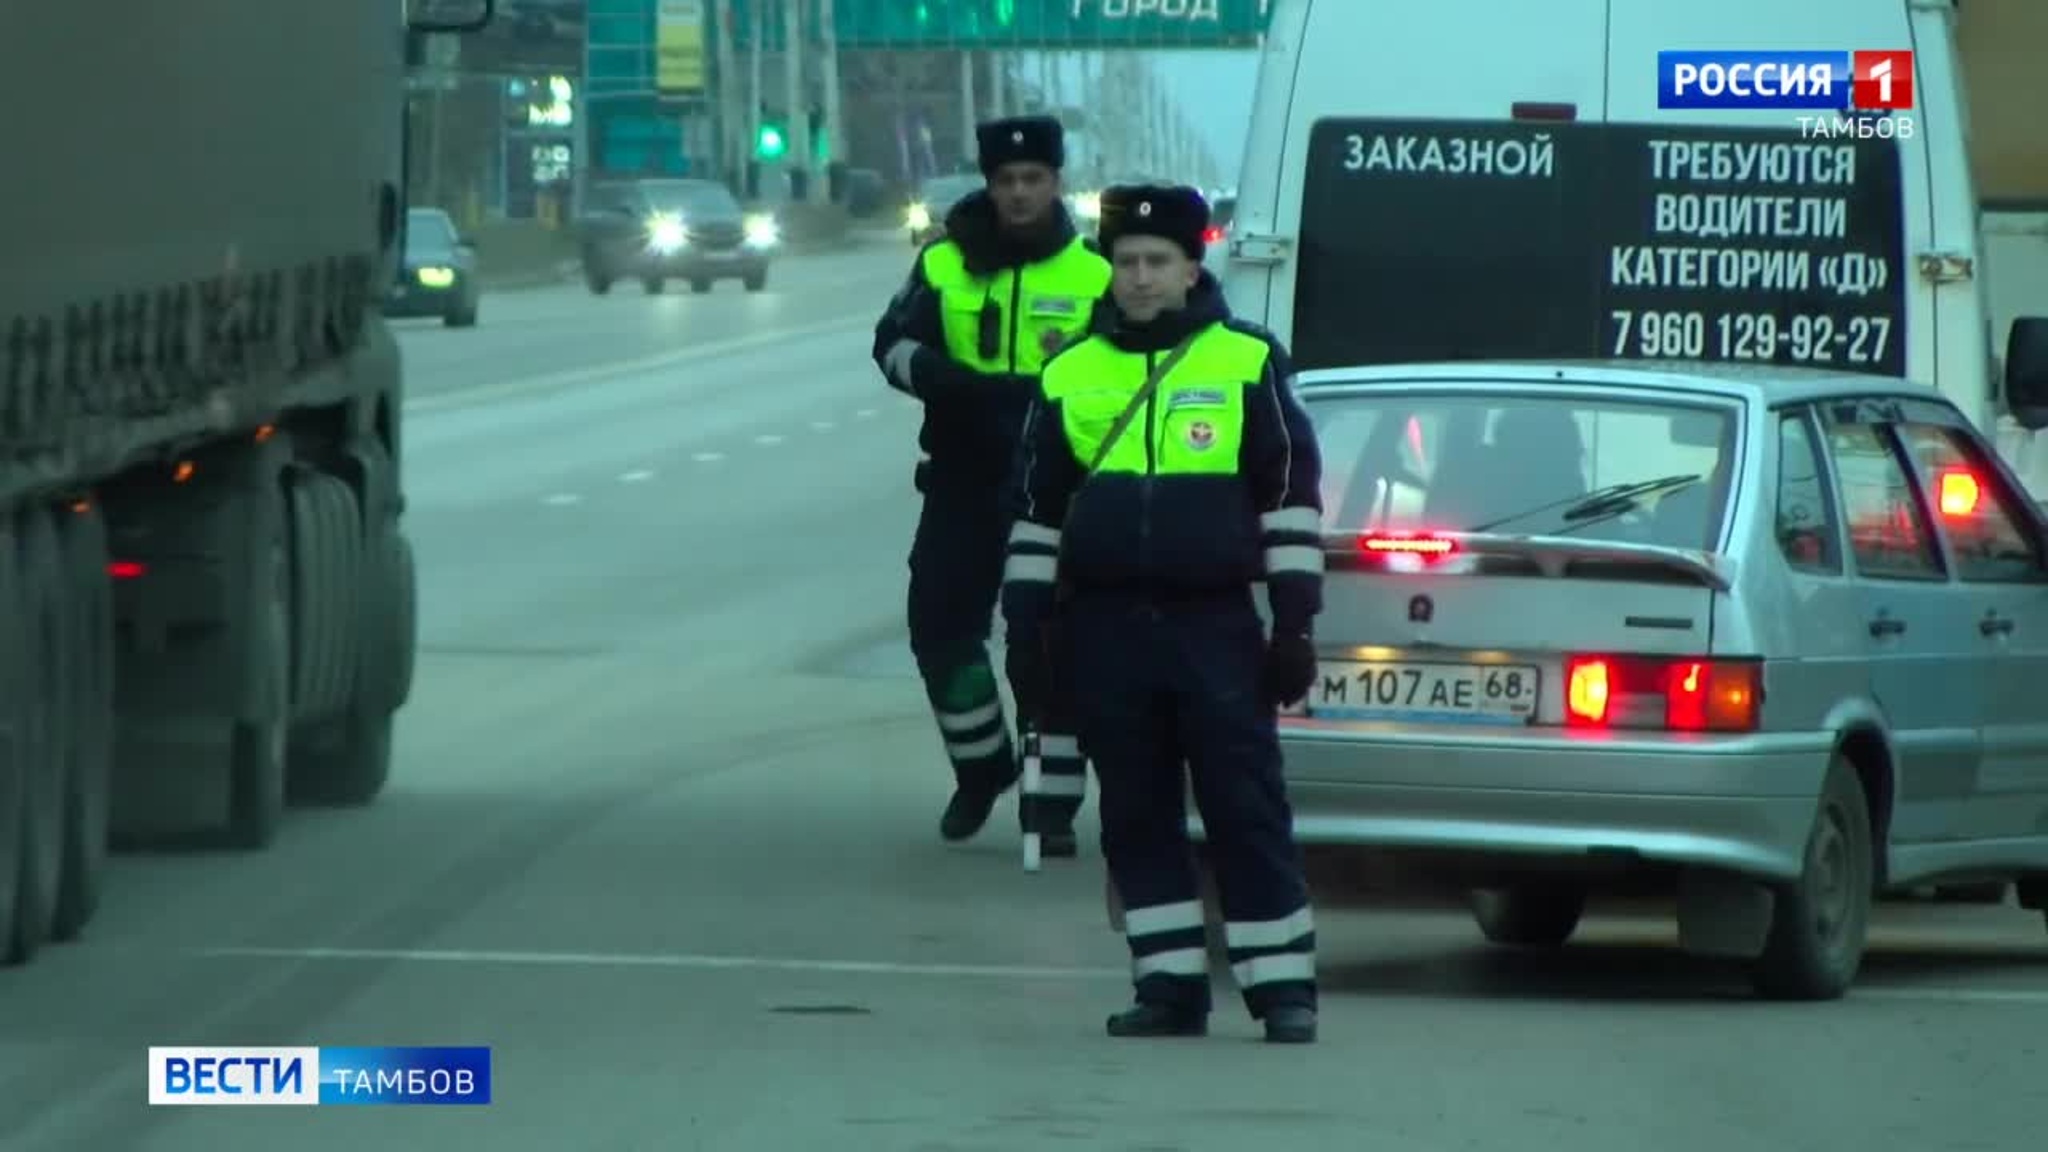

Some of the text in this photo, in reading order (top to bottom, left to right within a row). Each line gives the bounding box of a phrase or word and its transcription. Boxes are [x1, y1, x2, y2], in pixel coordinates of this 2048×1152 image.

[1343, 133, 1554, 177] ЗАКАЗНОЙ
[1648, 140, 1856, 184] ТРЕБУЮТСЯ
[1655, 194, 1847, 238] ВОДИТЕЛИ
[1611, 246, 1809, 290] КАТЕГОРИИ
[1717, 313, 1891, 362] 129-92-27
